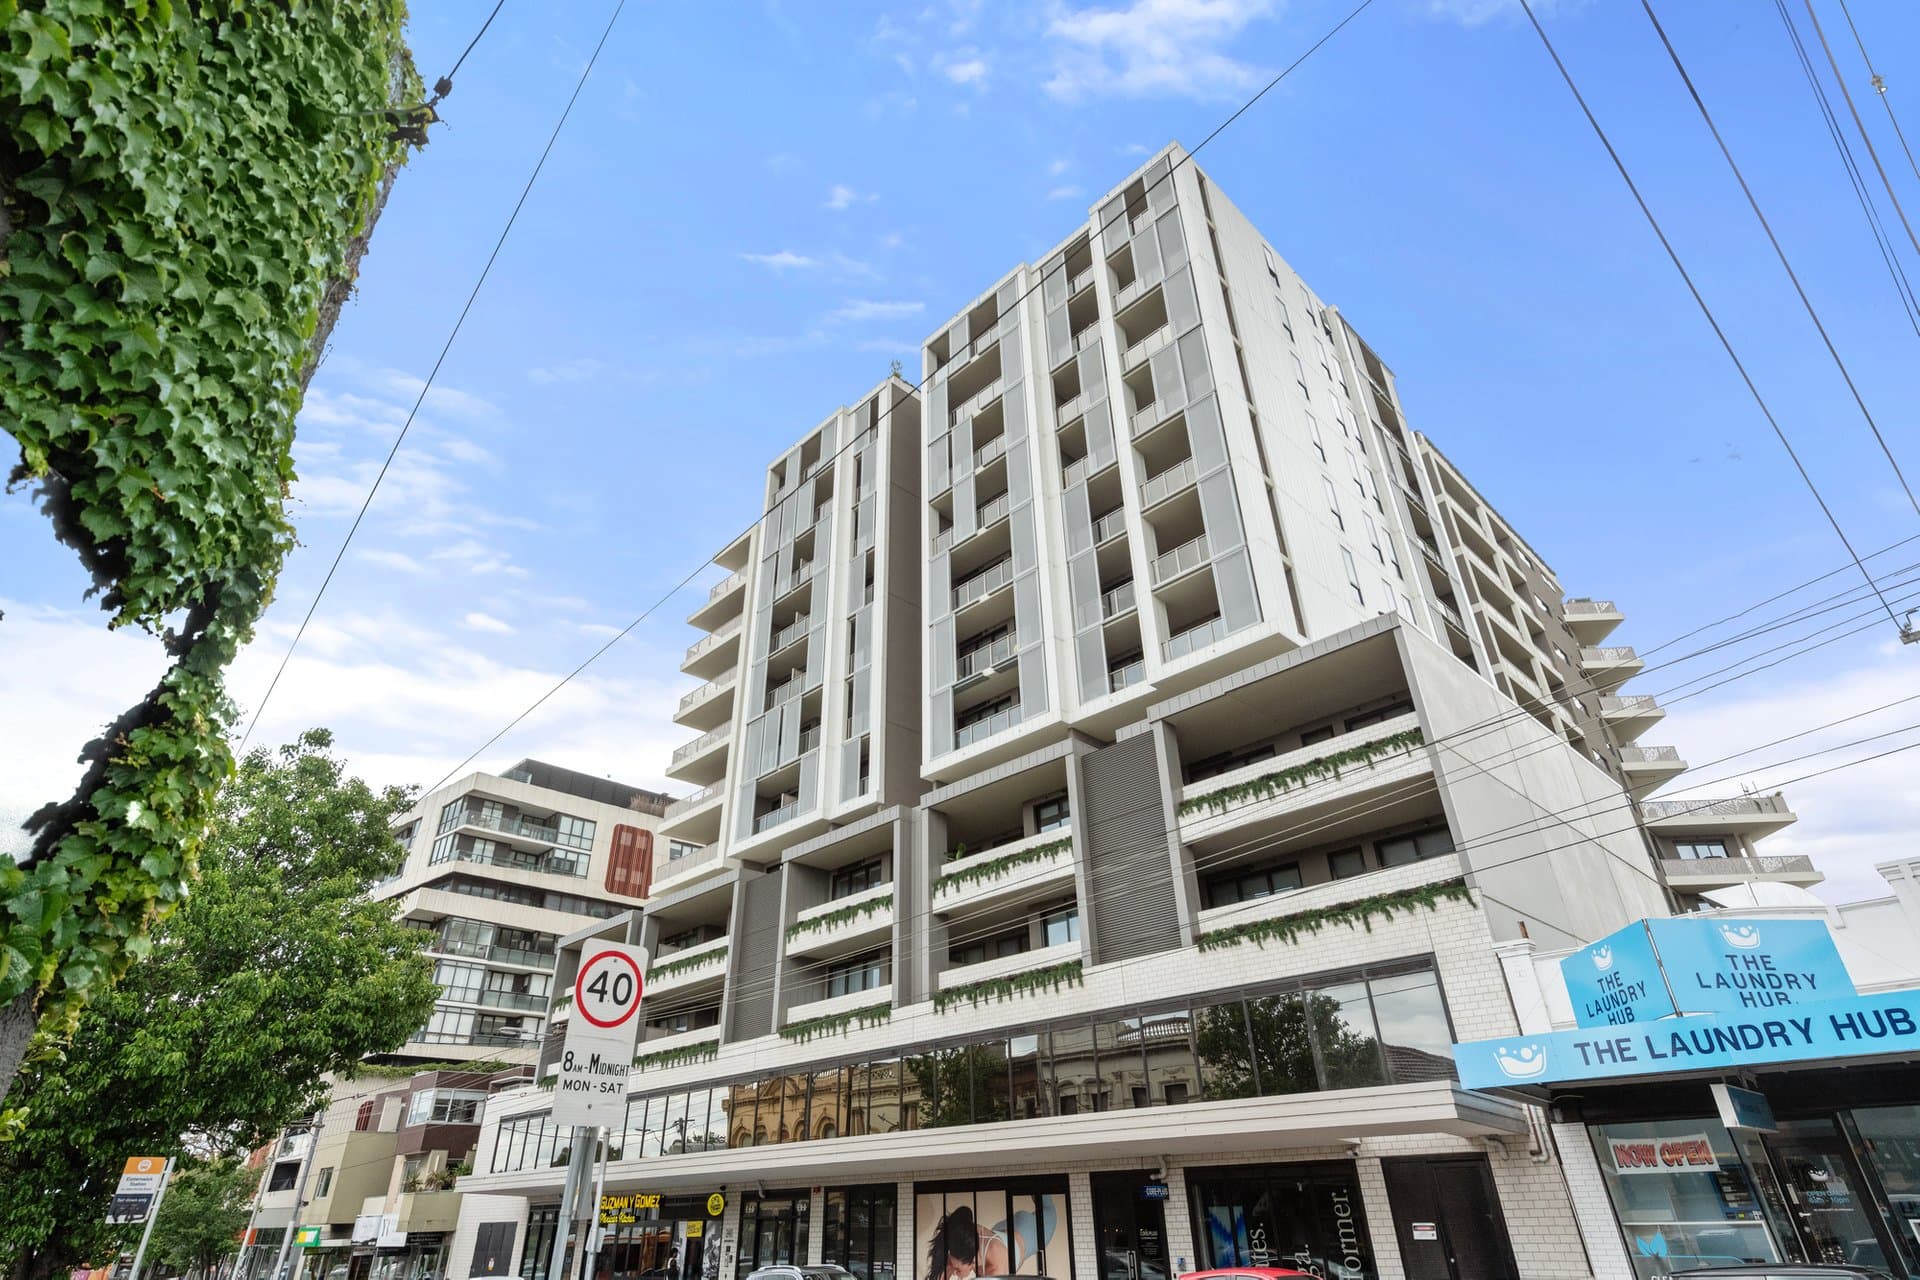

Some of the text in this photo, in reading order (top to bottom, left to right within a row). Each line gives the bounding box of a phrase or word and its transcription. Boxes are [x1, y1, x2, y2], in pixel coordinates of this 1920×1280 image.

[1725, 954, 1777, 971] THE
[586, 970, 632, 1006] 40
[1597, 971, 1624, 994] THE
[1696, 972, 1817, 990] LAUNDRY
[1585, 980, 1647, 1018] LAUNDRY
[1607, 1006, 1635, 1026] HUB
[1573, 1008, 1917, 1066] THE LAUNDRY HUB
[562, 1079, 591, 1092] MON
[600, 1082, 624, 1095] SAT
[1613, 1140, 1714, 1168] NOW OPEN
[600, 1195, 629, 1210] GUZMAN
[635, 1193, 660, 1208] GOMEZ
